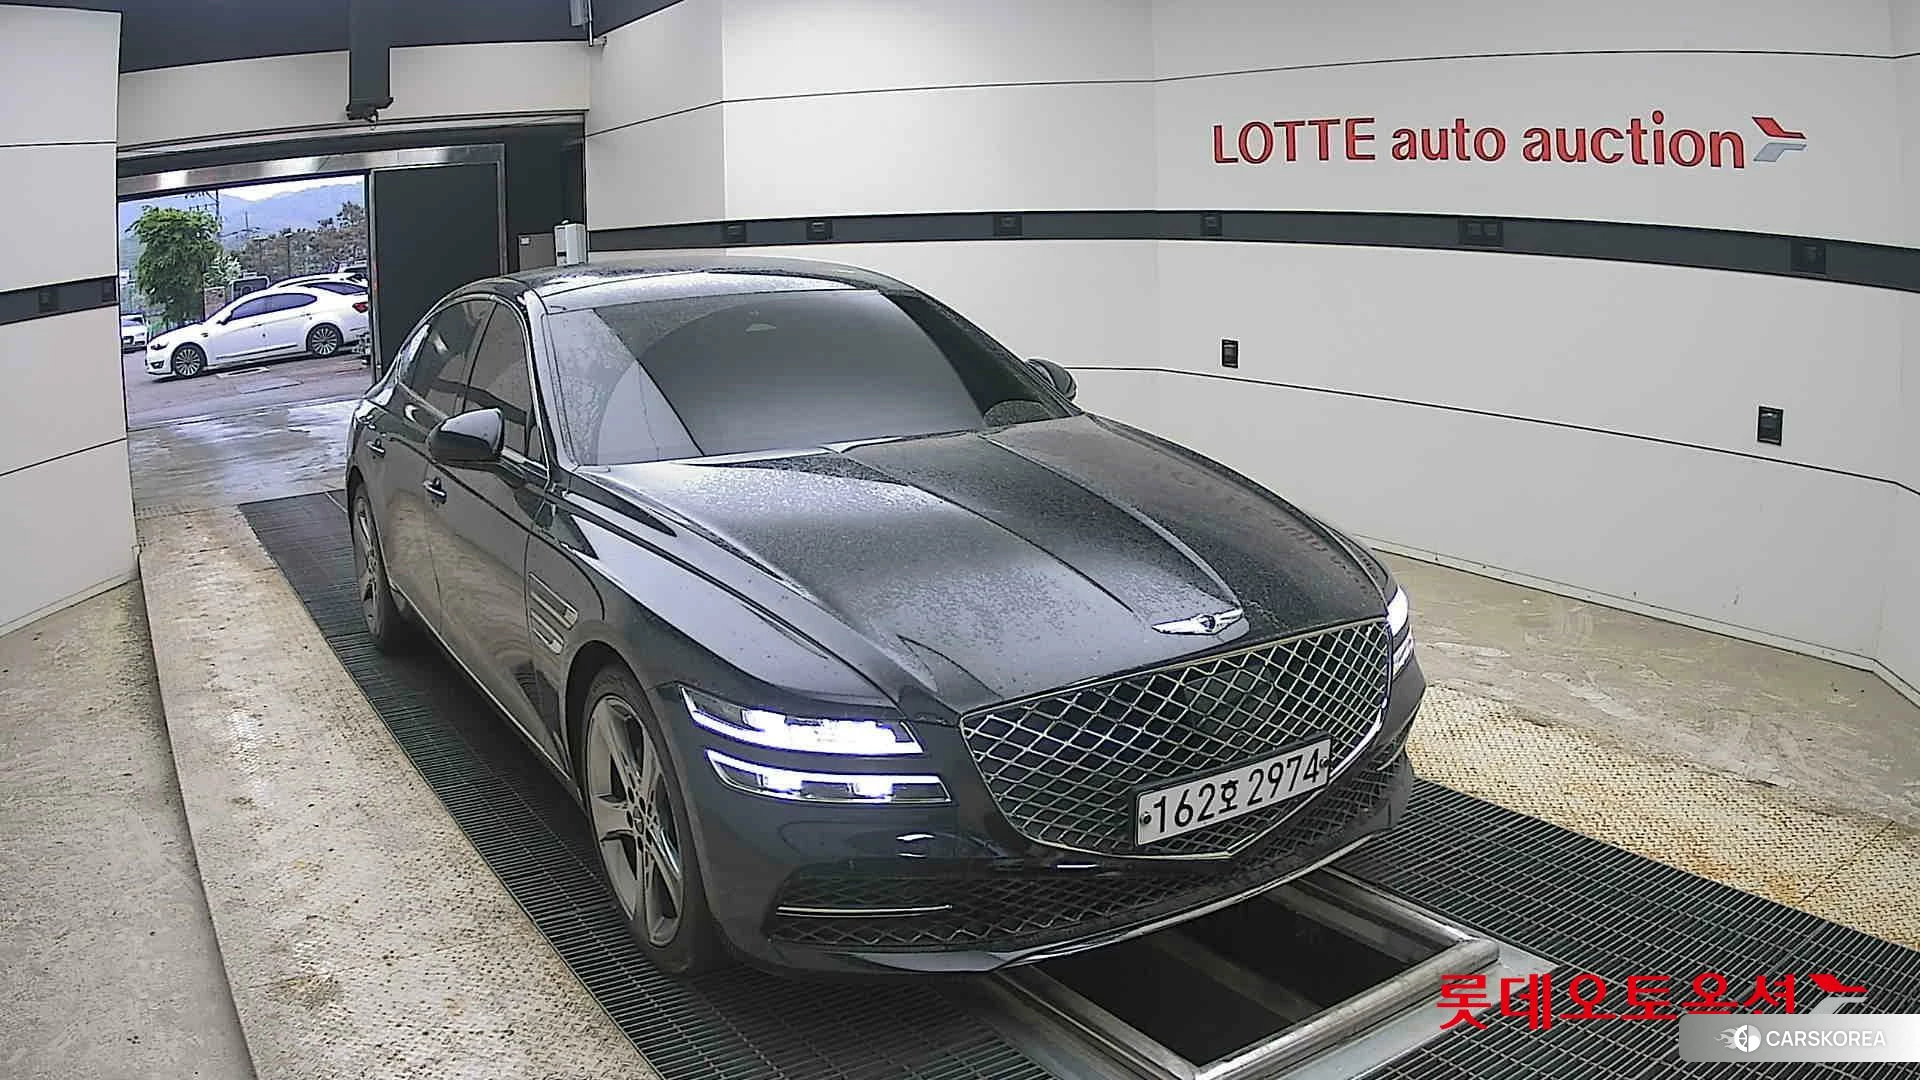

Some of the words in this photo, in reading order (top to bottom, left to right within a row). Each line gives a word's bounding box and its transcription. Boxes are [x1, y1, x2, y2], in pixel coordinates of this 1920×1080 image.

[1213, 117, 1376, 164] LOTTE
[1391, 118, 1506, 161] auto
[1522, 110, 1745, 169] auction
[1153, 779, 1239, 833] 162호
[1247, 748, 1320, 807] 2974
